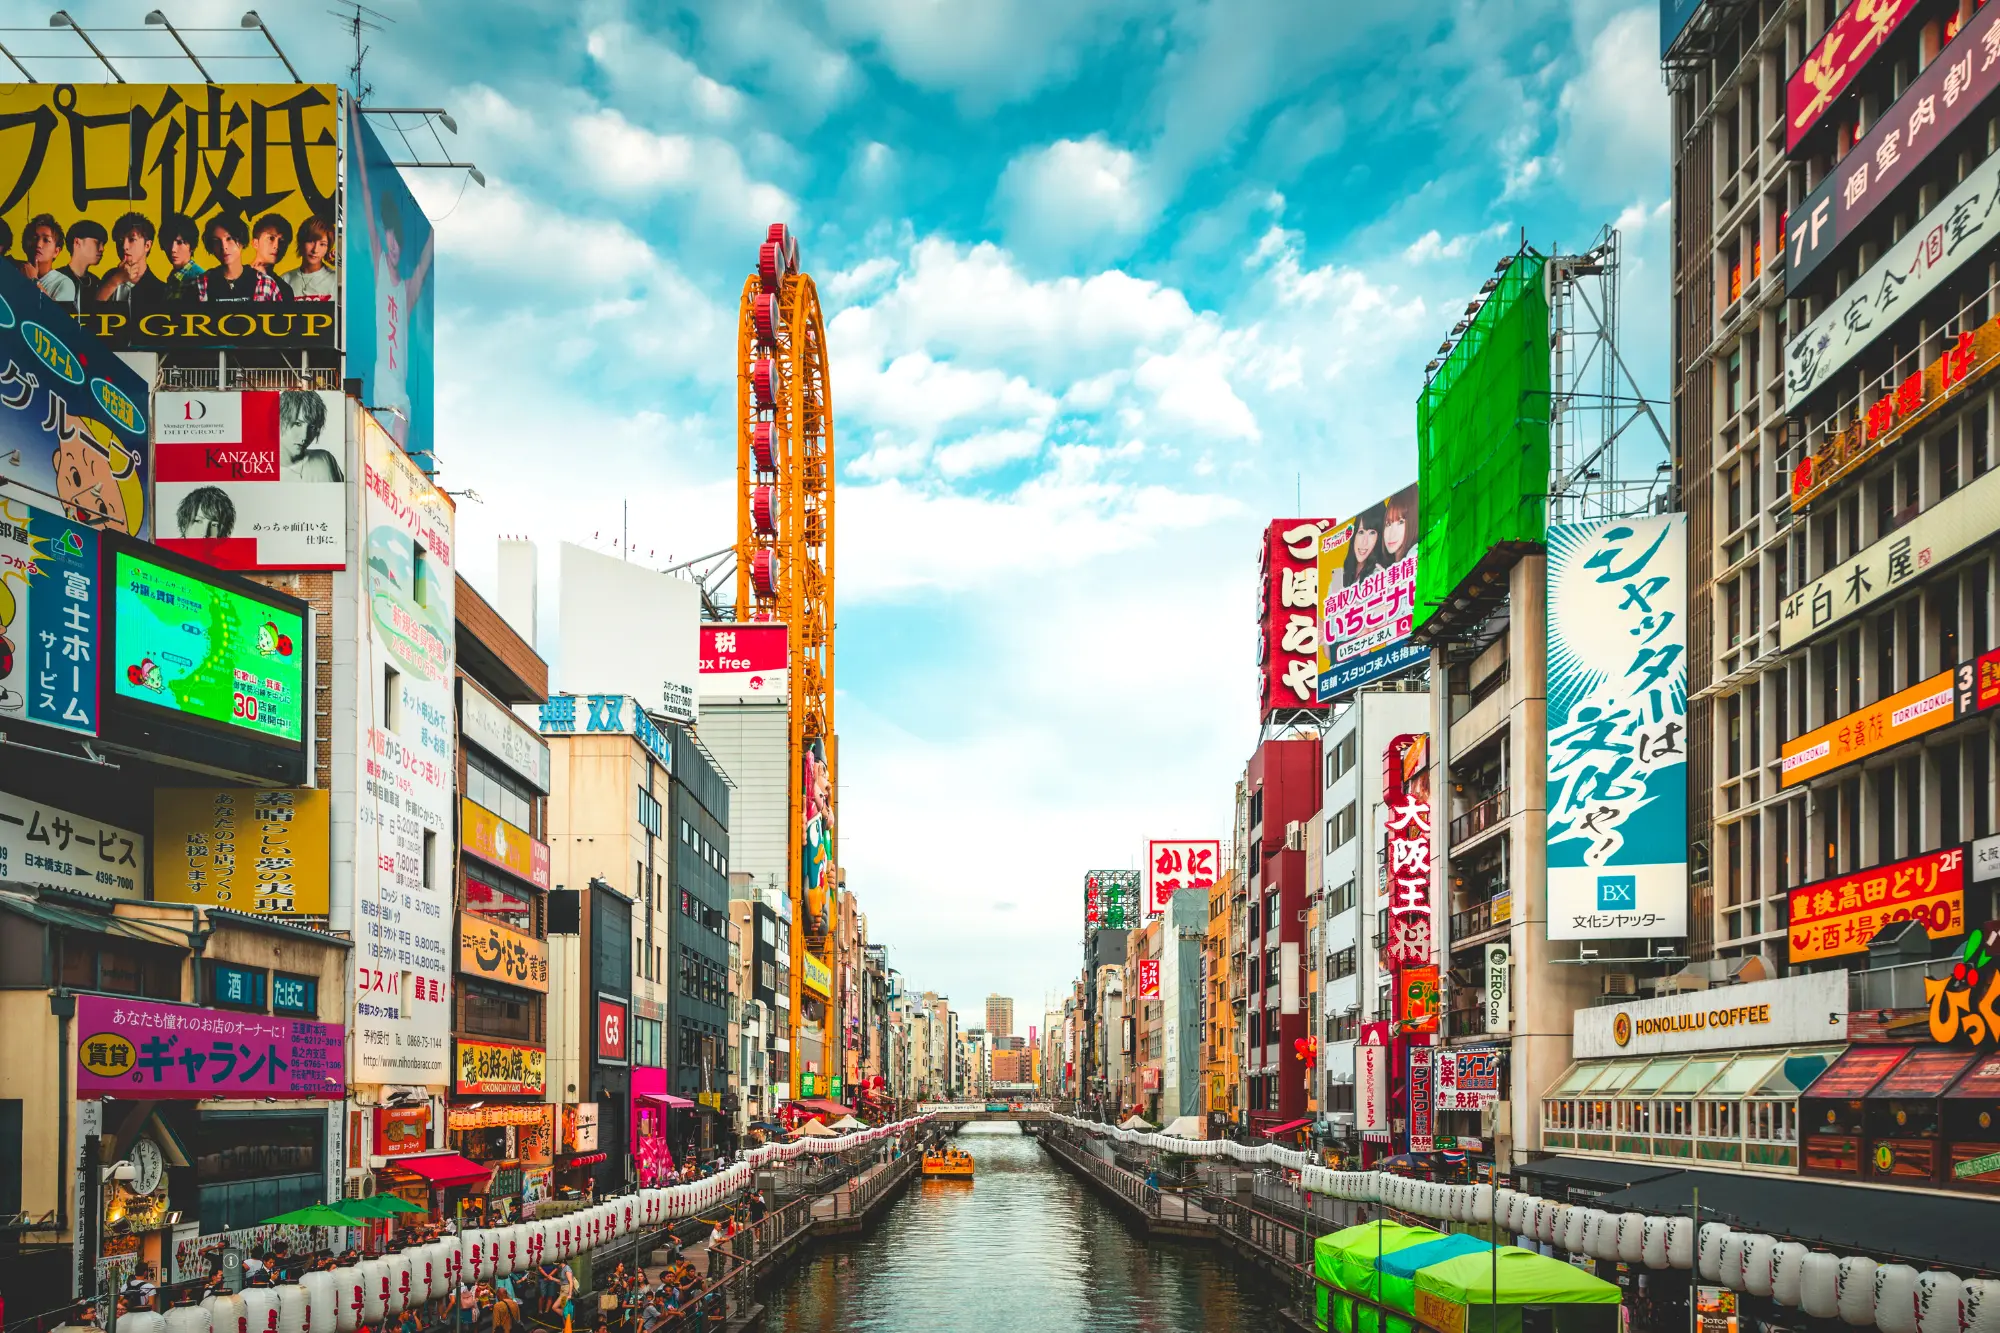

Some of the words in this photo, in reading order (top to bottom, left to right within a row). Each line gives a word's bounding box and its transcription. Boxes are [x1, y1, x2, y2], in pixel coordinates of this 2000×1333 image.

[0, 84, 336, 220] プロ彼氏
[1791, 196, 1830, 268] 7F
[139, 313, 333, 337] GROUP
[34, 328, 73, 379] リフォーム
[205, 448, 275, 469] KANZAKI
[231, 461, 275, 479] RUKA
[252, 522, 329, 532] めっちゃ面白いを
[1325, 557, 1418, 616] 高収入お仕事情
[1812, 535, 1914, 629] 白木屋
[1785, 592, 1804, 620] 4F
[62, 570, 91, 725] 富士ホーム
[714, 632, 737, 654] 税
[1339, 634, 1374, 658] いちごナビ
[1377, 627, 1392, 642] 求人
[38, 630, 57, 711] サービス
[719, 657, 752, 670] Free
[233, 693, 258, 721] 30
[538, 696, 624, 732] 無双
[1893, 696, 1947, 725] TORIKIZOKU
[1783, 747, 1824, 772] TORIKIZOKU
[213, 793, 236, 903] あなたのお店づくり
[254, 792, 296, 912] 素晴らしい夢の実現
[1155, 847, 1212, 875] かに
[1940, 849, 1963, 872] 2F
[25, 852, 73, 876] 日本橋支店
[186, 832, 210, 894] 応援します
[1388, 796, 1431, 962] 大阪王将
[1603, 885, 1631, 901] BX
[1790, 862, 1939, 922] 豊後高田どり
[476, 929, 528, 980] うなぎ
[227, 972, 242, 1000] 酒
[359, 967, 398, 996] コスパ
[1149, 962, 1158, 985] ツルハ
[1490, 967, 1503, 1001] ZERO
[274, 979, 304, 1008] たばこ
[415, 976, 446, 1004] 最高!
[112, 1009, 286, 1039] あなたも憧れのお店のオーナーに!
[1490, 1002, 1500, 1026] cafe
[1636, 1012, 1706, 1036] HONOLULU
[1708, 1004, 1771, 1028] COFFEE
[363, 1029, 389, 1046] 予約受付
[605, 1014, 619, 1045] G3
[87, 1041, 129, 1068] 賃貸
[138, 1035, 288, 1085] ギャラント
[478, 1048, 523, 1081] お好み焼
[132, 1071, 143, 1084] の
[481, 1083, 521, 1093] OKONOMIYAKI
[1414, 1067, 1429, 1111] ダイコク
[1455, 1092, 1479, 1108] 免税
[1411, 1137, 1432, 1146] 免税
